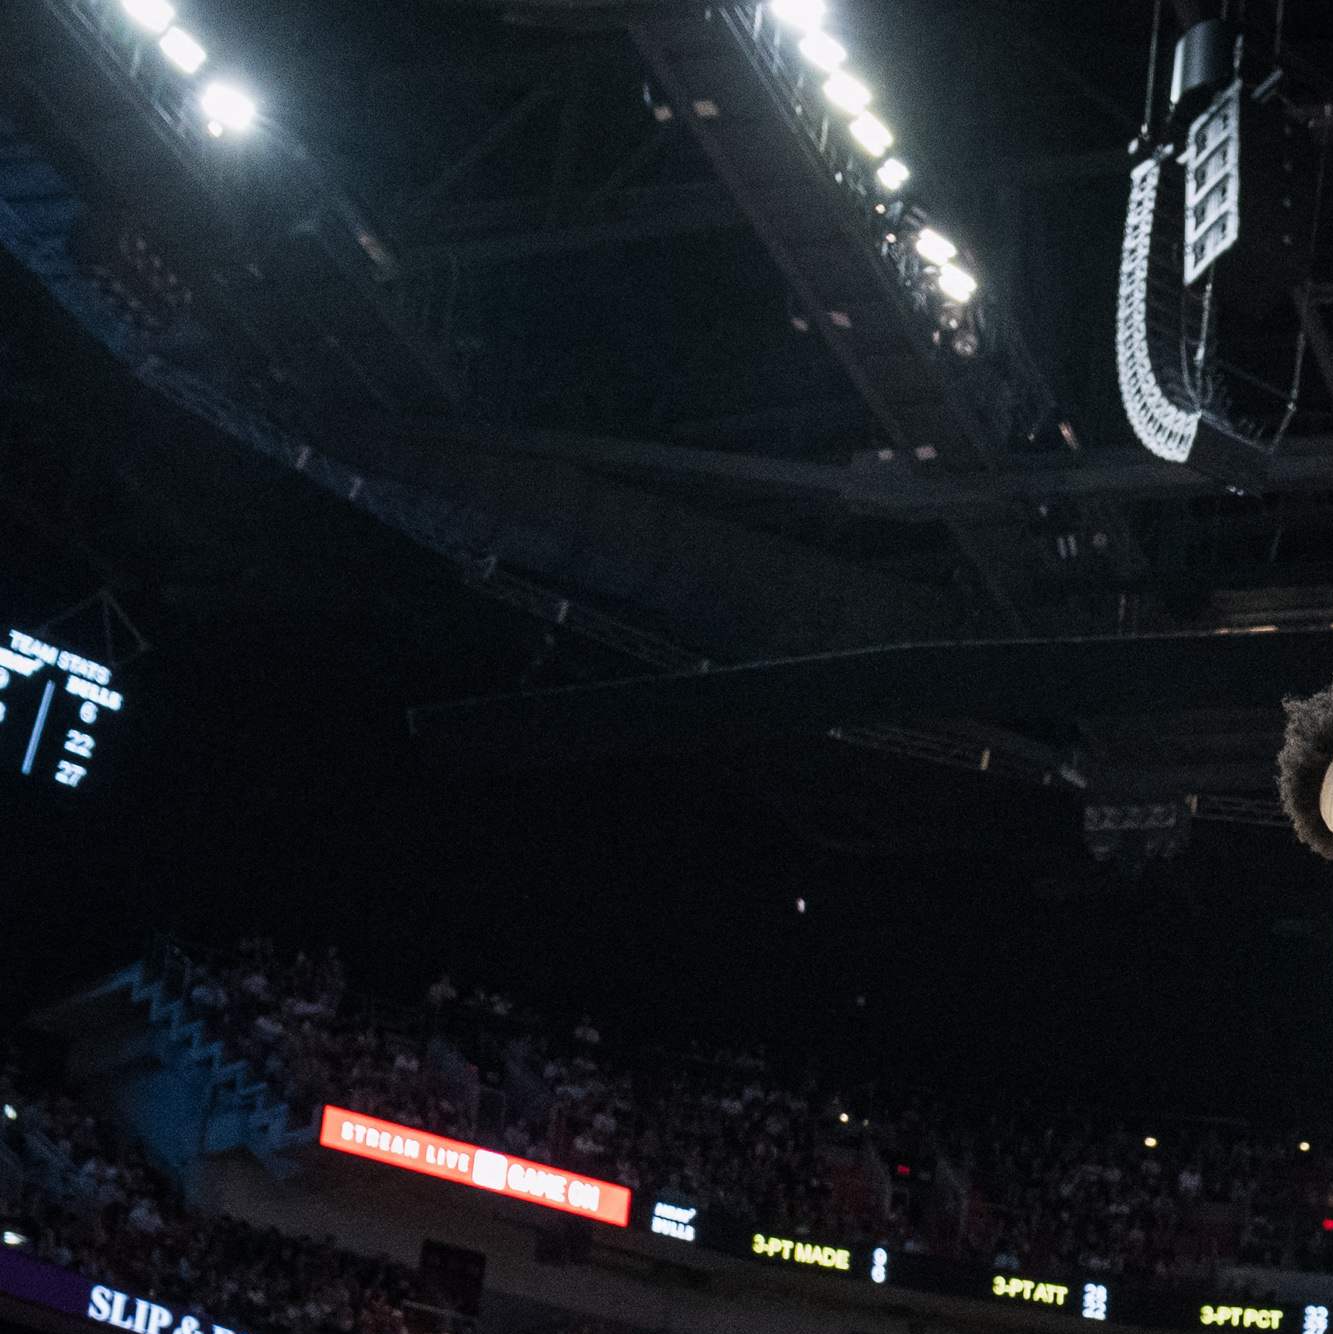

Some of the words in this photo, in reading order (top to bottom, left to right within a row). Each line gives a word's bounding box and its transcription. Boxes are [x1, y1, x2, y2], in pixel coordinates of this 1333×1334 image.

[57, 650, 112, 686] STATS
[341, 1121, 420, 1159] STREAM
[425, 1145, 471, 1174] LIVE
[752, 1233, 794, 1261] 3-PT
[794, 1242, 851, 1271] MADE
[992, 1275, 1035, 1300] 3-PT
[1033, 1281, 1069, 1306] ATT
[1199, 1305, 1243, 1327] 3-PT
